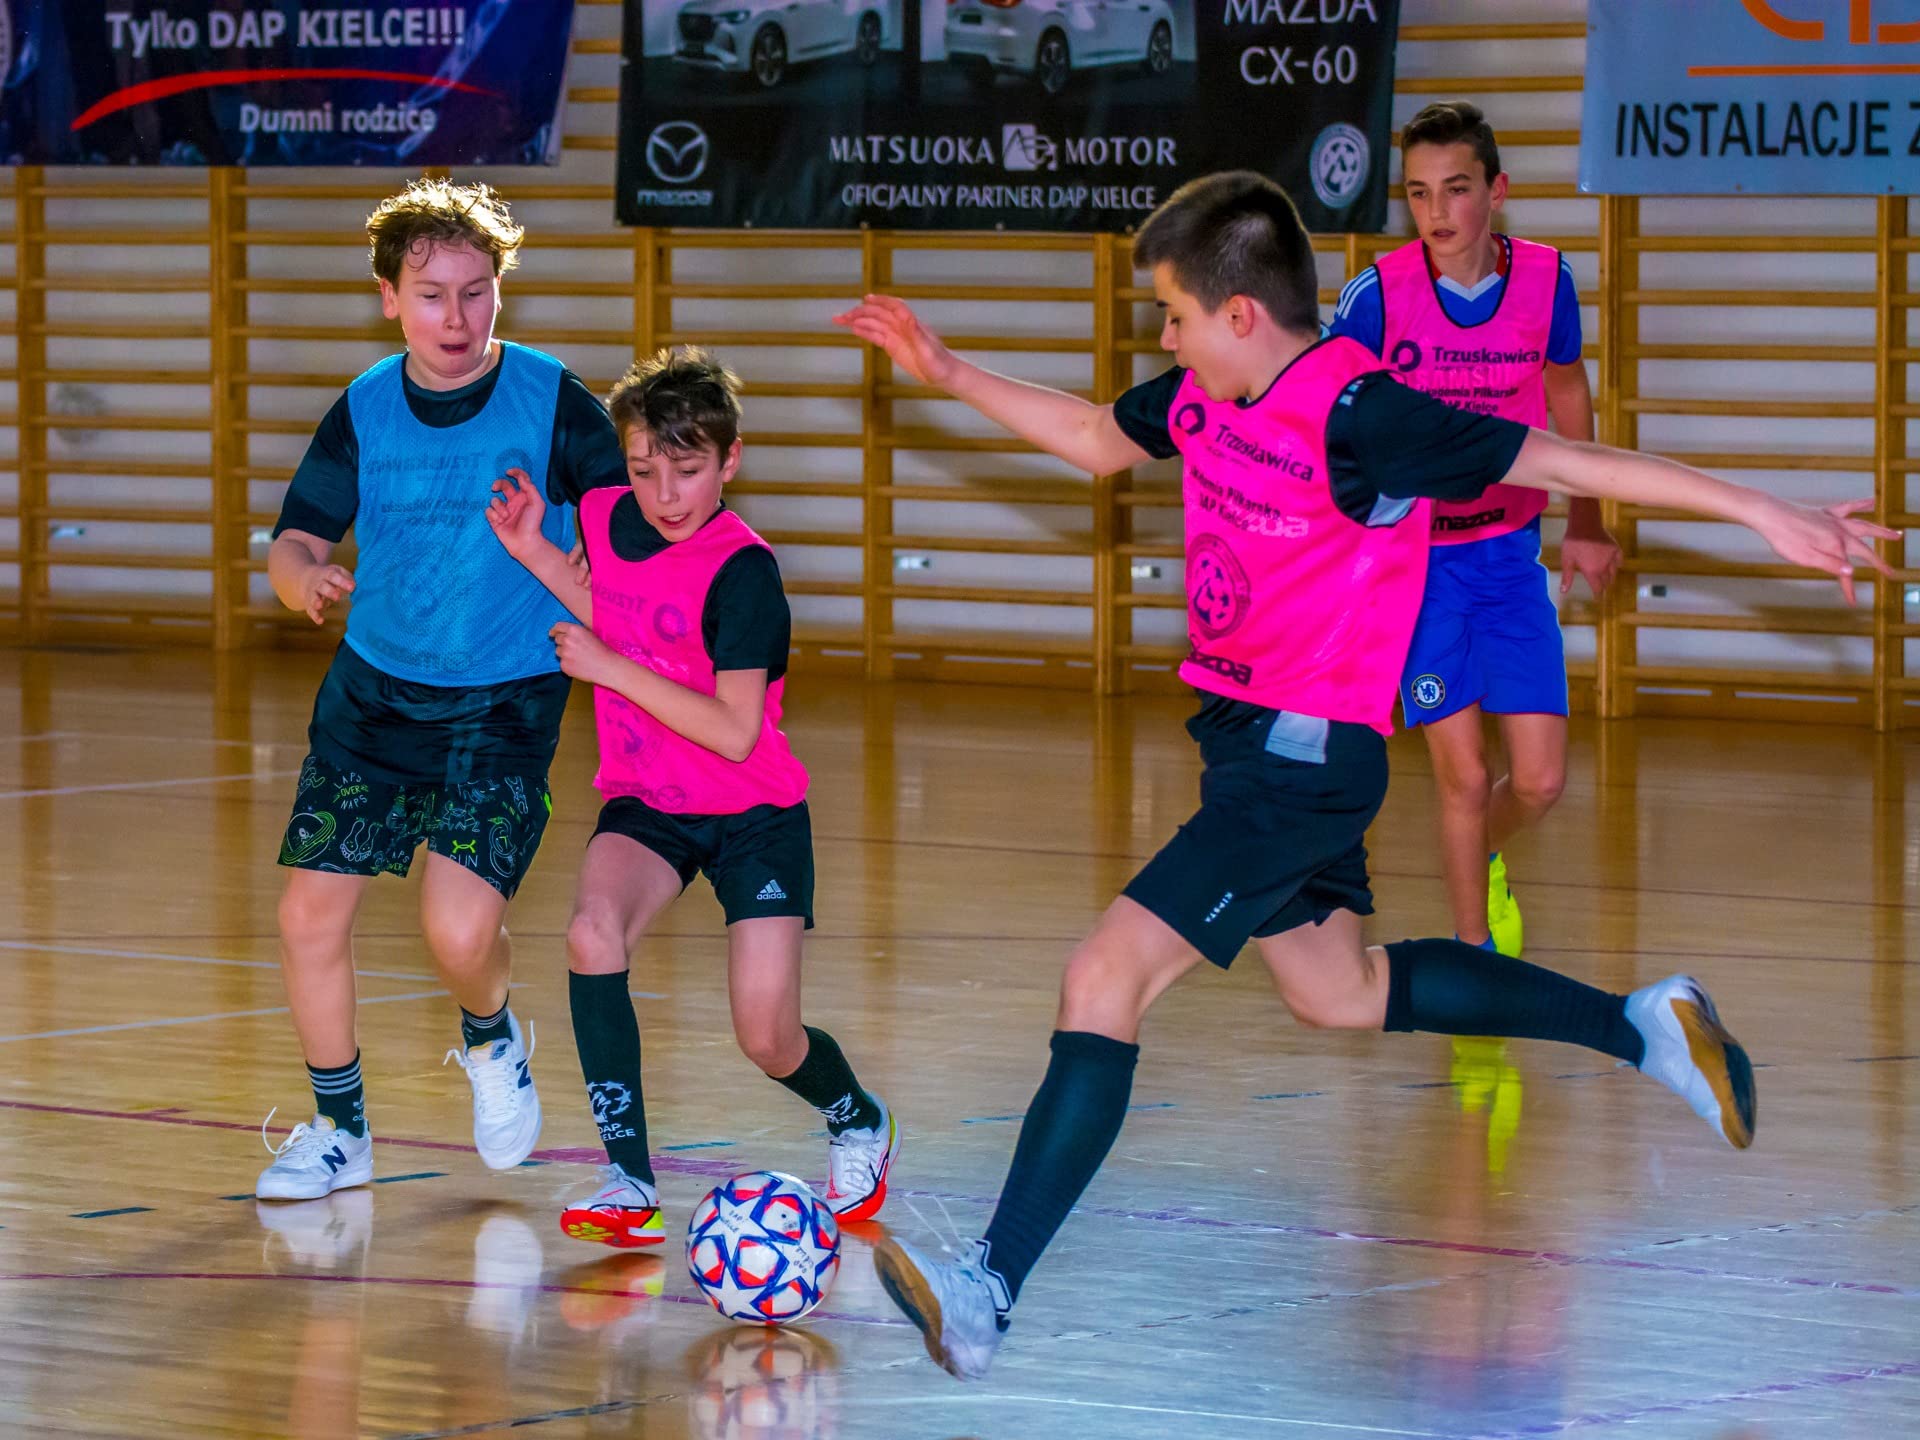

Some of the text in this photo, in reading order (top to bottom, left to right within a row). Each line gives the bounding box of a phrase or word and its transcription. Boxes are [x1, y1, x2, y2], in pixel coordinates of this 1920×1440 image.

[1223, 0, 1378, 25] MAZDA
[105, 7, 465, 57] Tylko DAP KIELCE!!!
[1240, 45, 1358, 85] CX-60
[240, 102, 437, 133] Dumni rodzice
[1616, 101, 1889, 157] INSTALACJE
[829, 135, 1177, 168] MATSUOKA MOTOR
[841, 184, 1157, 211] OFICJALNY PARTNER DAP KIELCE
[1433, 346, 1541, 364] Trzuskawica
[1215, 423, 1314, 482] Trzuskawica
[321, 1145, 348, 1175] N
